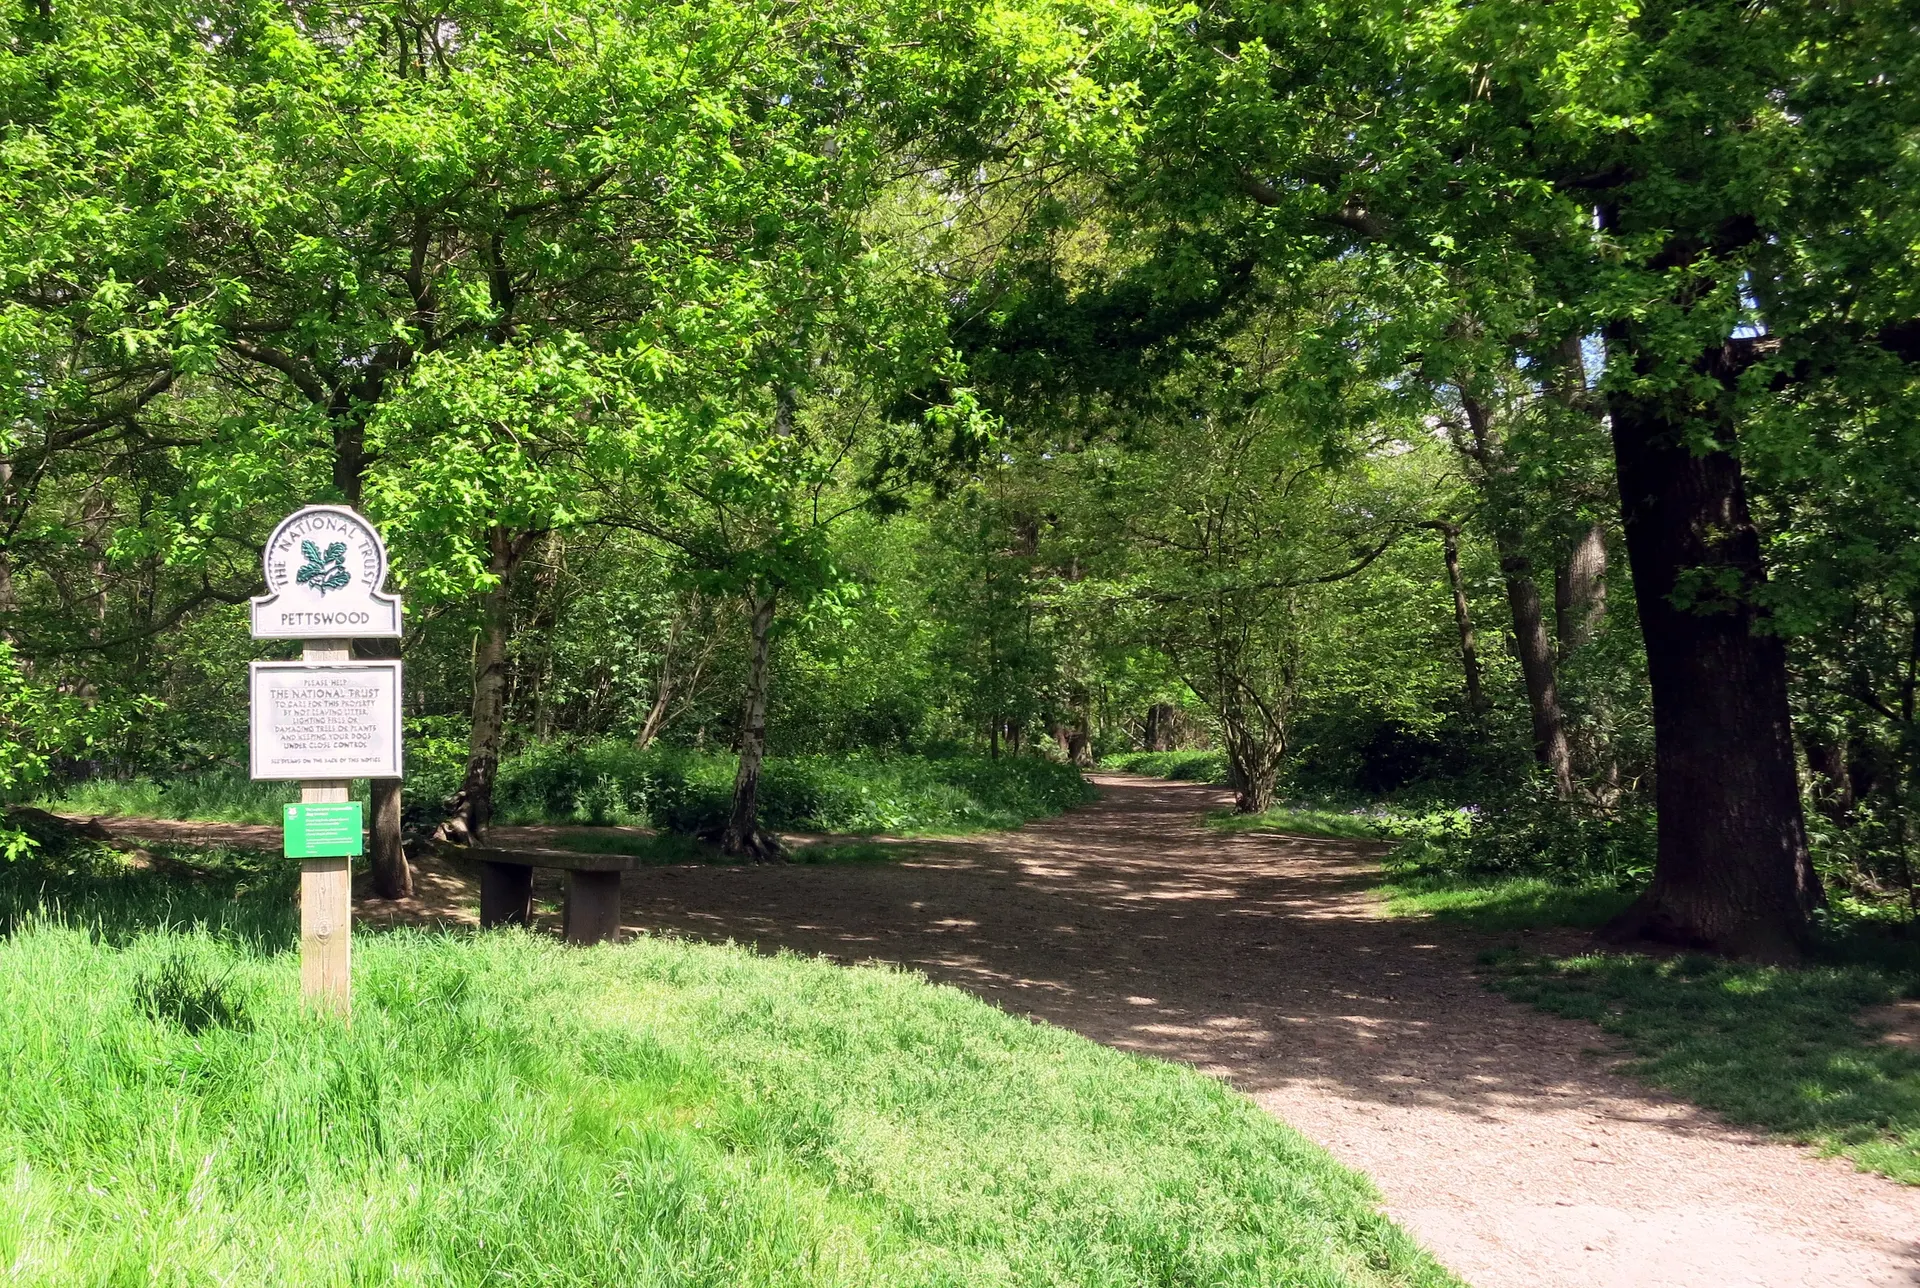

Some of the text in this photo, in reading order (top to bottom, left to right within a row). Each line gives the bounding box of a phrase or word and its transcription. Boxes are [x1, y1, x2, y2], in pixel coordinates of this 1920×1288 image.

[274, 517, 376, 588] THE NATIONAL TRUST
[281, 612, 369, 625] PETTSWOOD
[270, 688, 380, 699] THE NATIONAL TRUST
[275, 700, 286, 708] TO
[288, 700, 306, 708] CARE
[308, 700, 322, 708] FOR
[341, 699, 376, 707] PROPERTY
[347, 716, 358, 724] OR
[298, 733, 327, 741] KEEPING
[351, 732, 371, 740] DOGS
